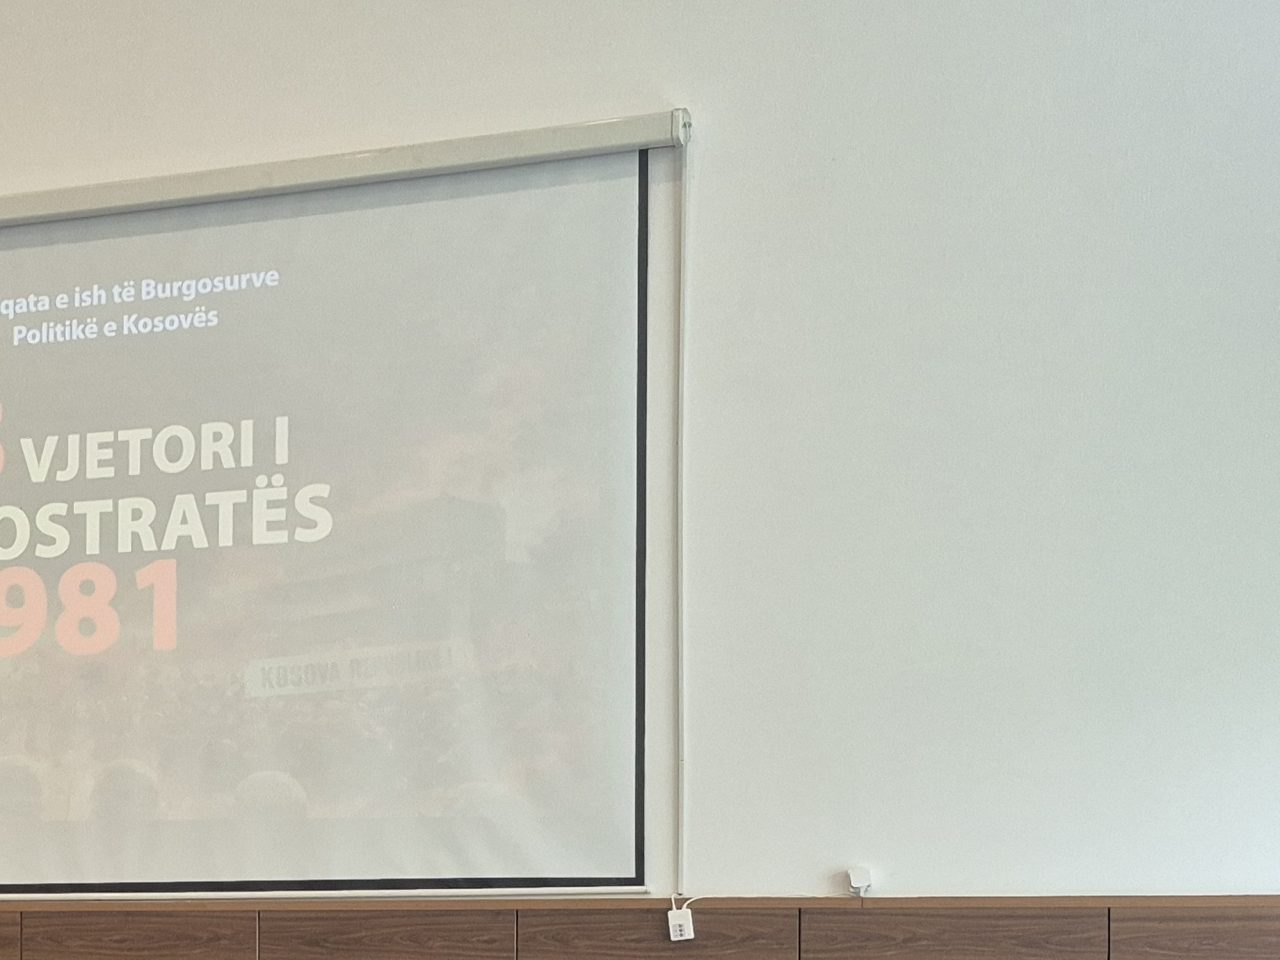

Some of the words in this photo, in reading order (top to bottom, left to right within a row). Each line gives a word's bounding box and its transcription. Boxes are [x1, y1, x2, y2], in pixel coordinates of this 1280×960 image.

[54, 291, 70, 309] e
[74, 283, 107, 307] ish
[112, 280, 136, 303] të
[141, 270, 281, 304] Burgosurve
[13, 319, 99, 346] Politikë
[103, 320, 118, 337] e
[123, 308, 219, 334] Kosovës
[20, 418, 255, 483] VJETORI
[275, 415, 290, 465] I
